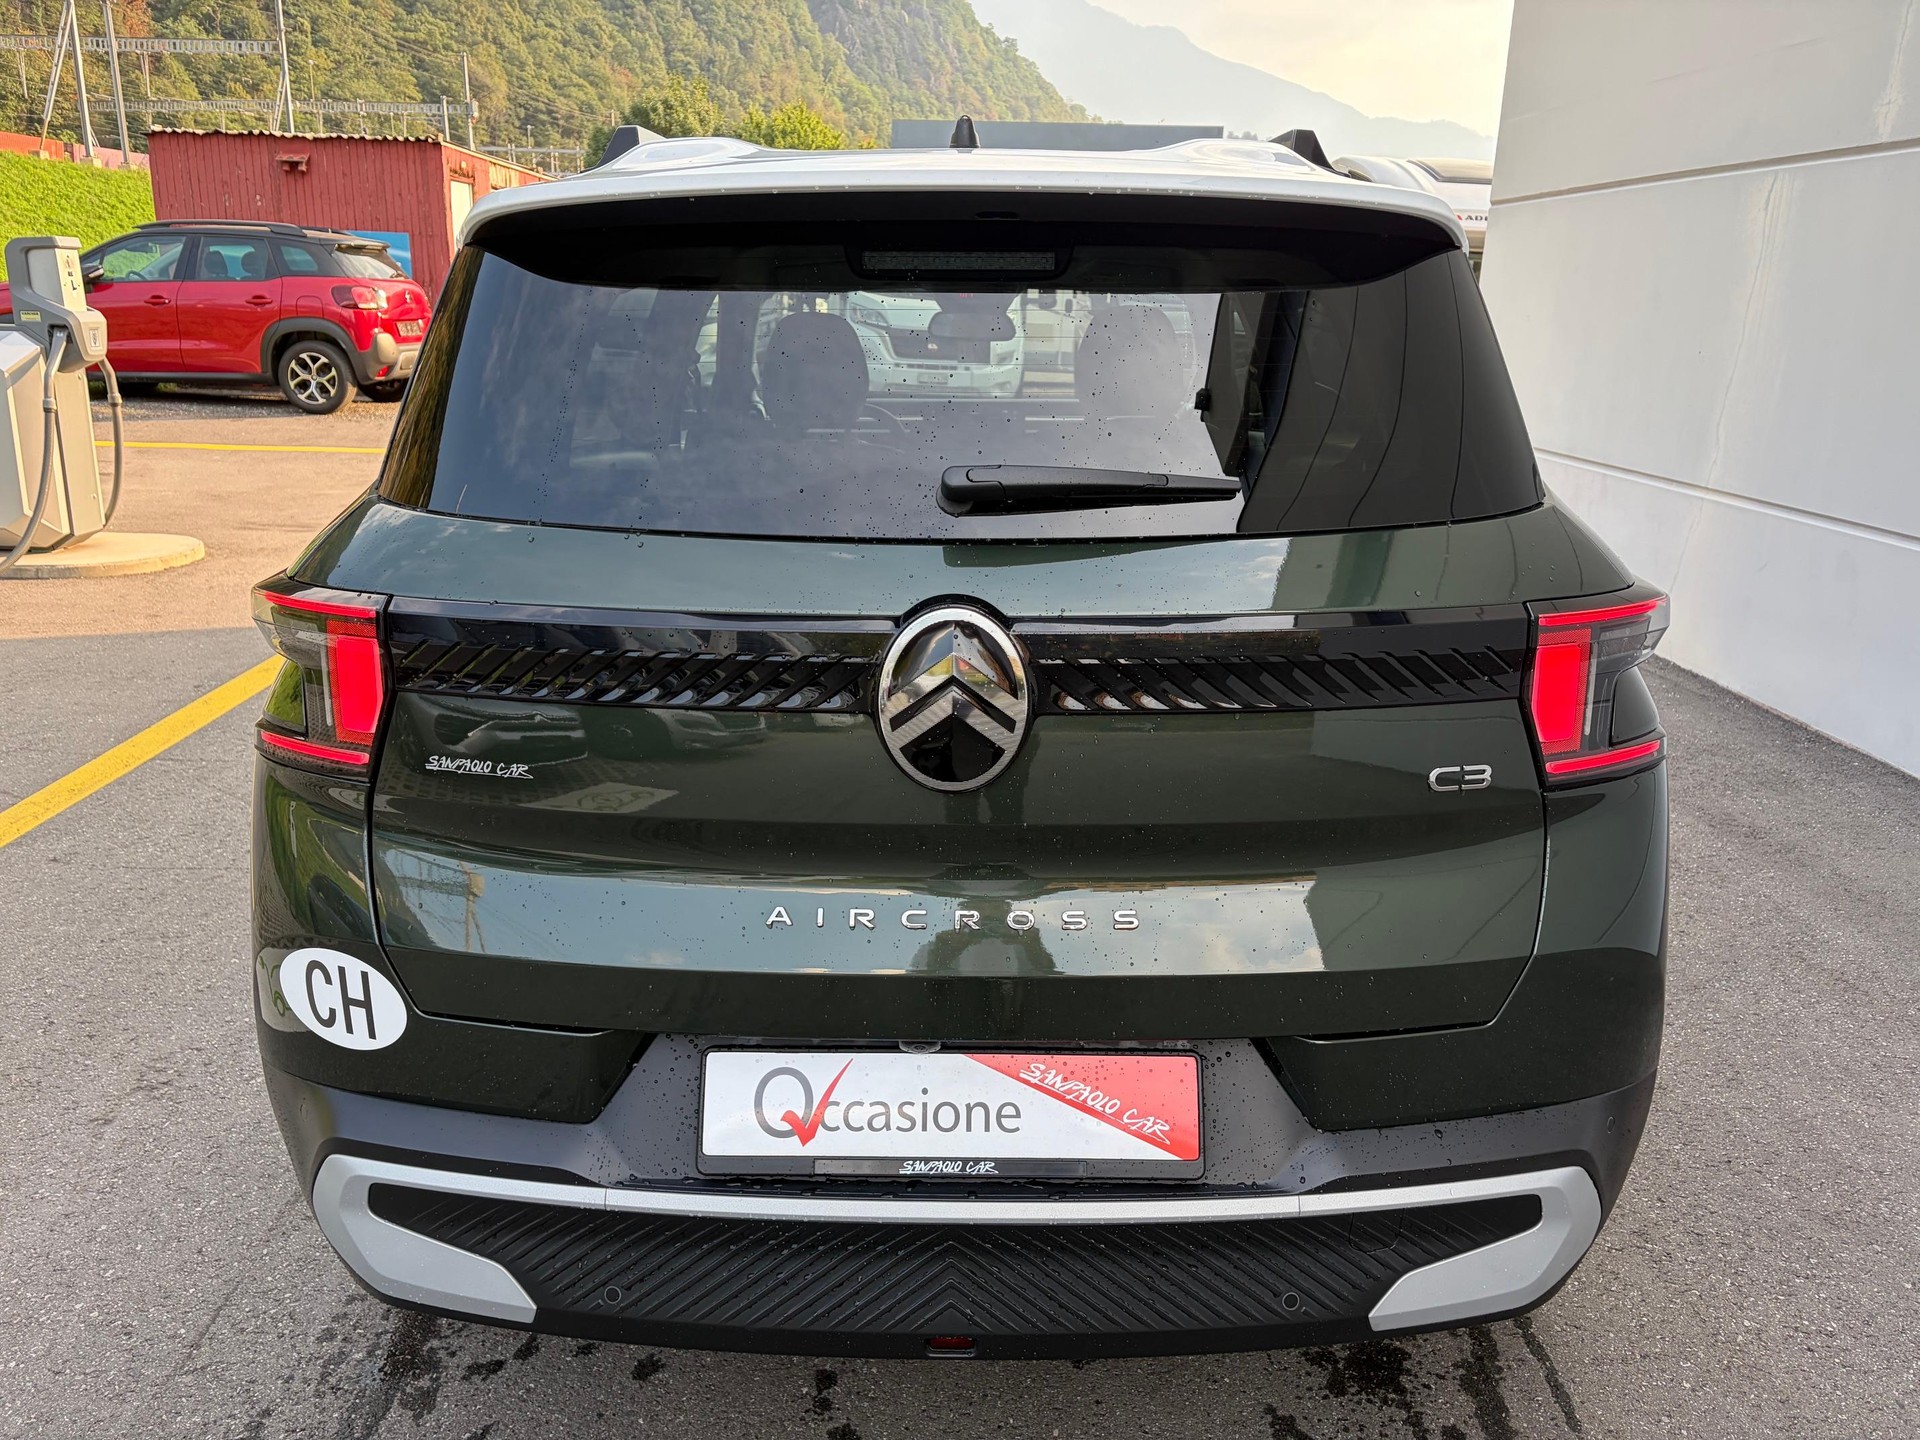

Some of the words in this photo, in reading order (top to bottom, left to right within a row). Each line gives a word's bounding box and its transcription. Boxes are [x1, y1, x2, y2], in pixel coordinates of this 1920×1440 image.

[425, 755, 492, 774] SANPAOLO
[496, 762, 534, 779] CAR
[1428, 764, 1492, 792] C3
[765, 906, 1140, 931] AIRCROSS
[305, 959, 377, 1040] CH
[1019, 1063, 1121, 1114] SANPAOLO
[1122, 1108, 1171, 1145] CAR
[899, 1160, 963, 1174] SANPAOLO
[965, 1161, 999, 1174] CAR
